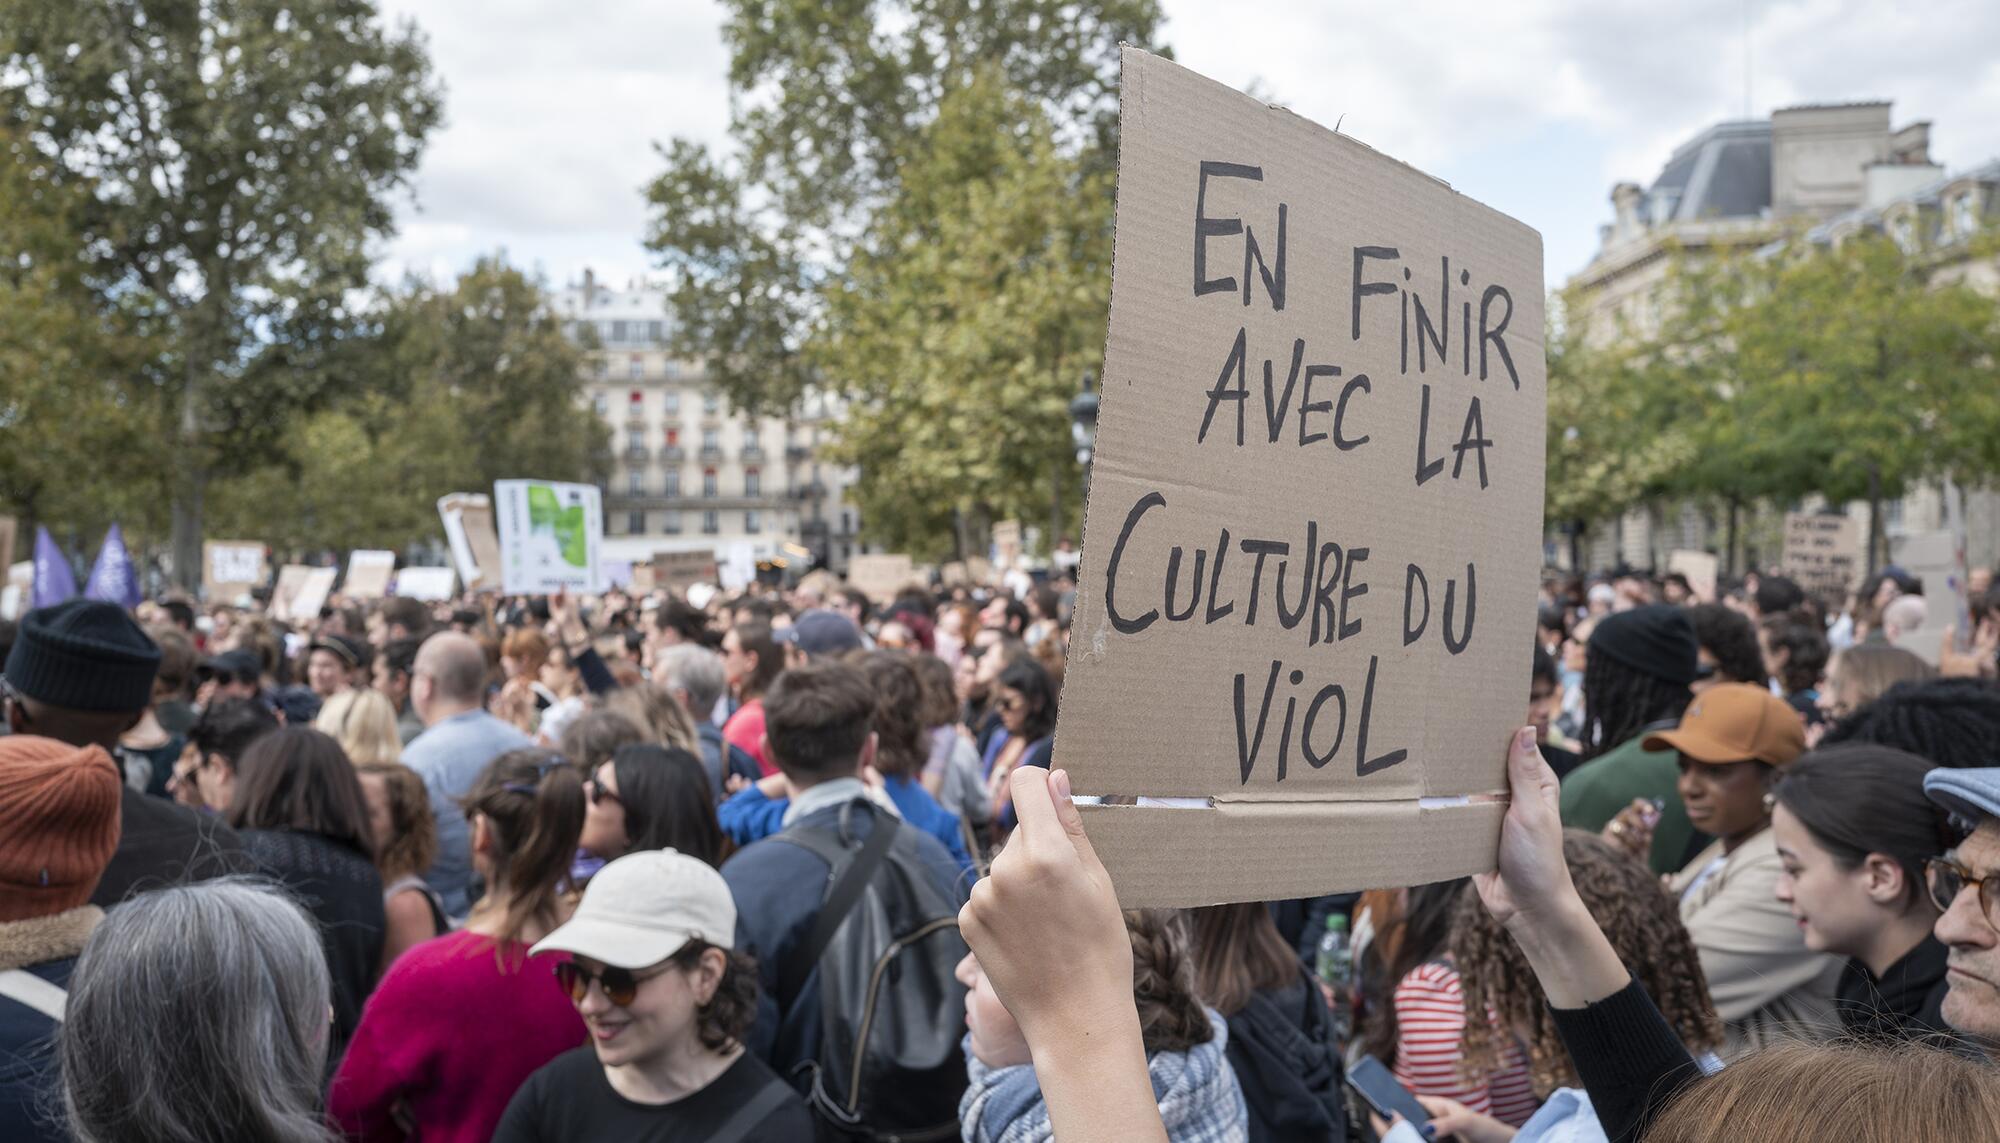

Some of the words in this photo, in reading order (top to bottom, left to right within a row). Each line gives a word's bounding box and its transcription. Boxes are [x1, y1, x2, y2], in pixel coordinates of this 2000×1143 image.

[1194, 160, 1288, 312] EN
[1197, 326, 1371, 452] AVEC
[1415, 384, 1494, 490] LA
[1104, 491, 1370, 648] CULTURE
[1403, 562, 1477, 656] DU
